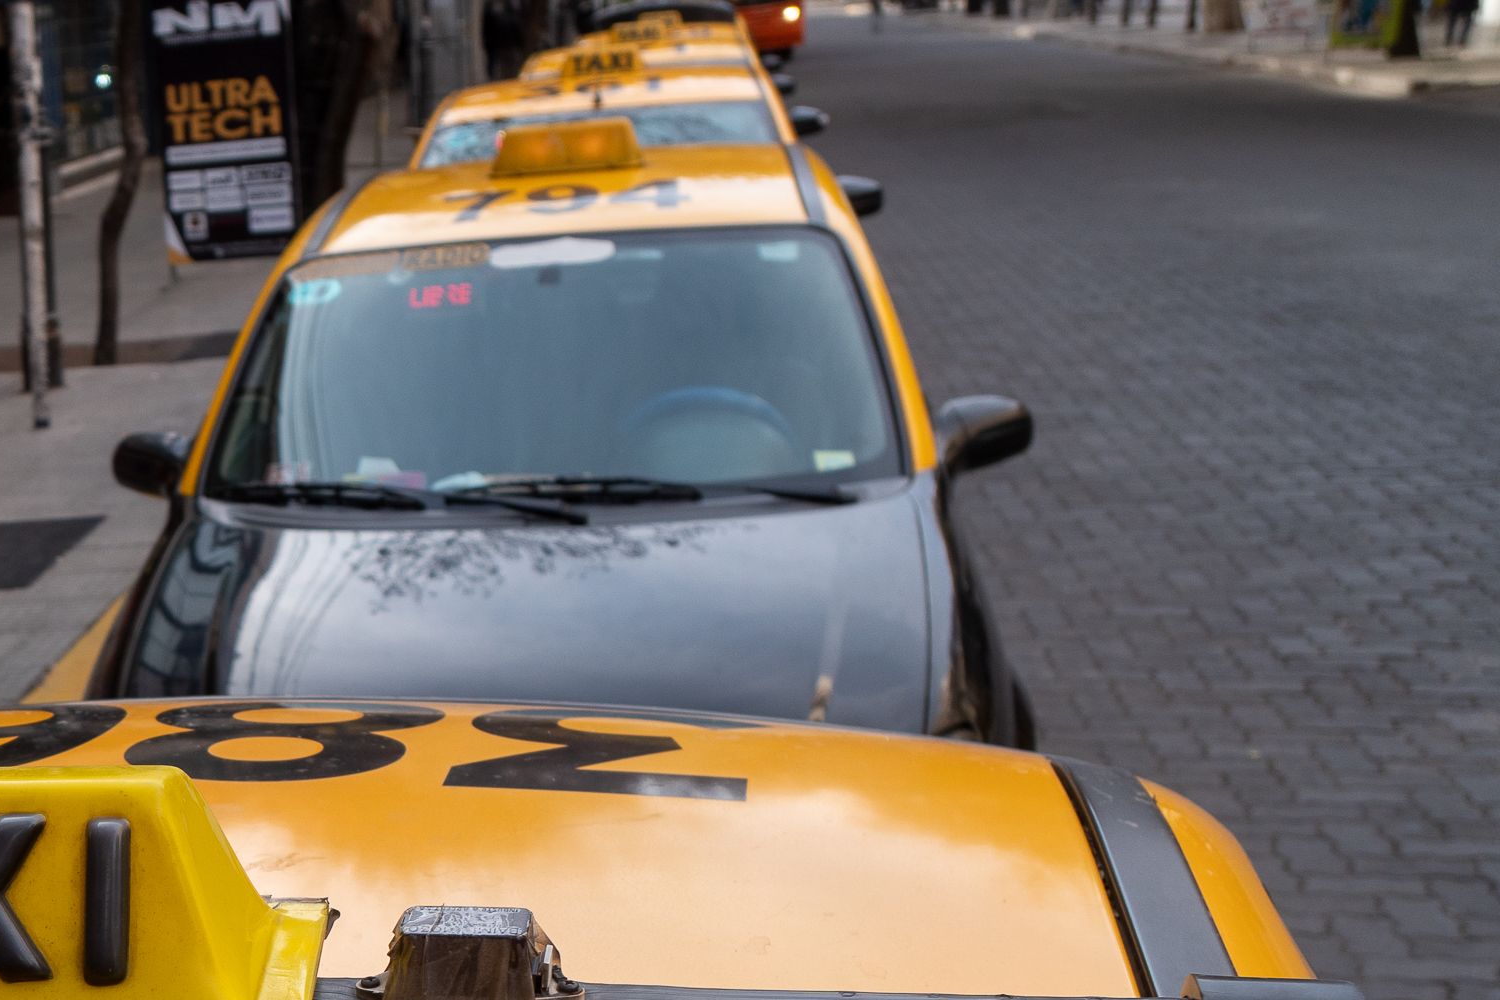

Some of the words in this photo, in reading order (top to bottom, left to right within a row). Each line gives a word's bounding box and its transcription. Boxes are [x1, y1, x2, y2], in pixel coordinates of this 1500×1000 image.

[573, 52, 633, 75] TAXI
[165, 75, 279, 112] ULTRA
[167, 102, 283, 142] TECH
[443, 180, 691, 222] 794
